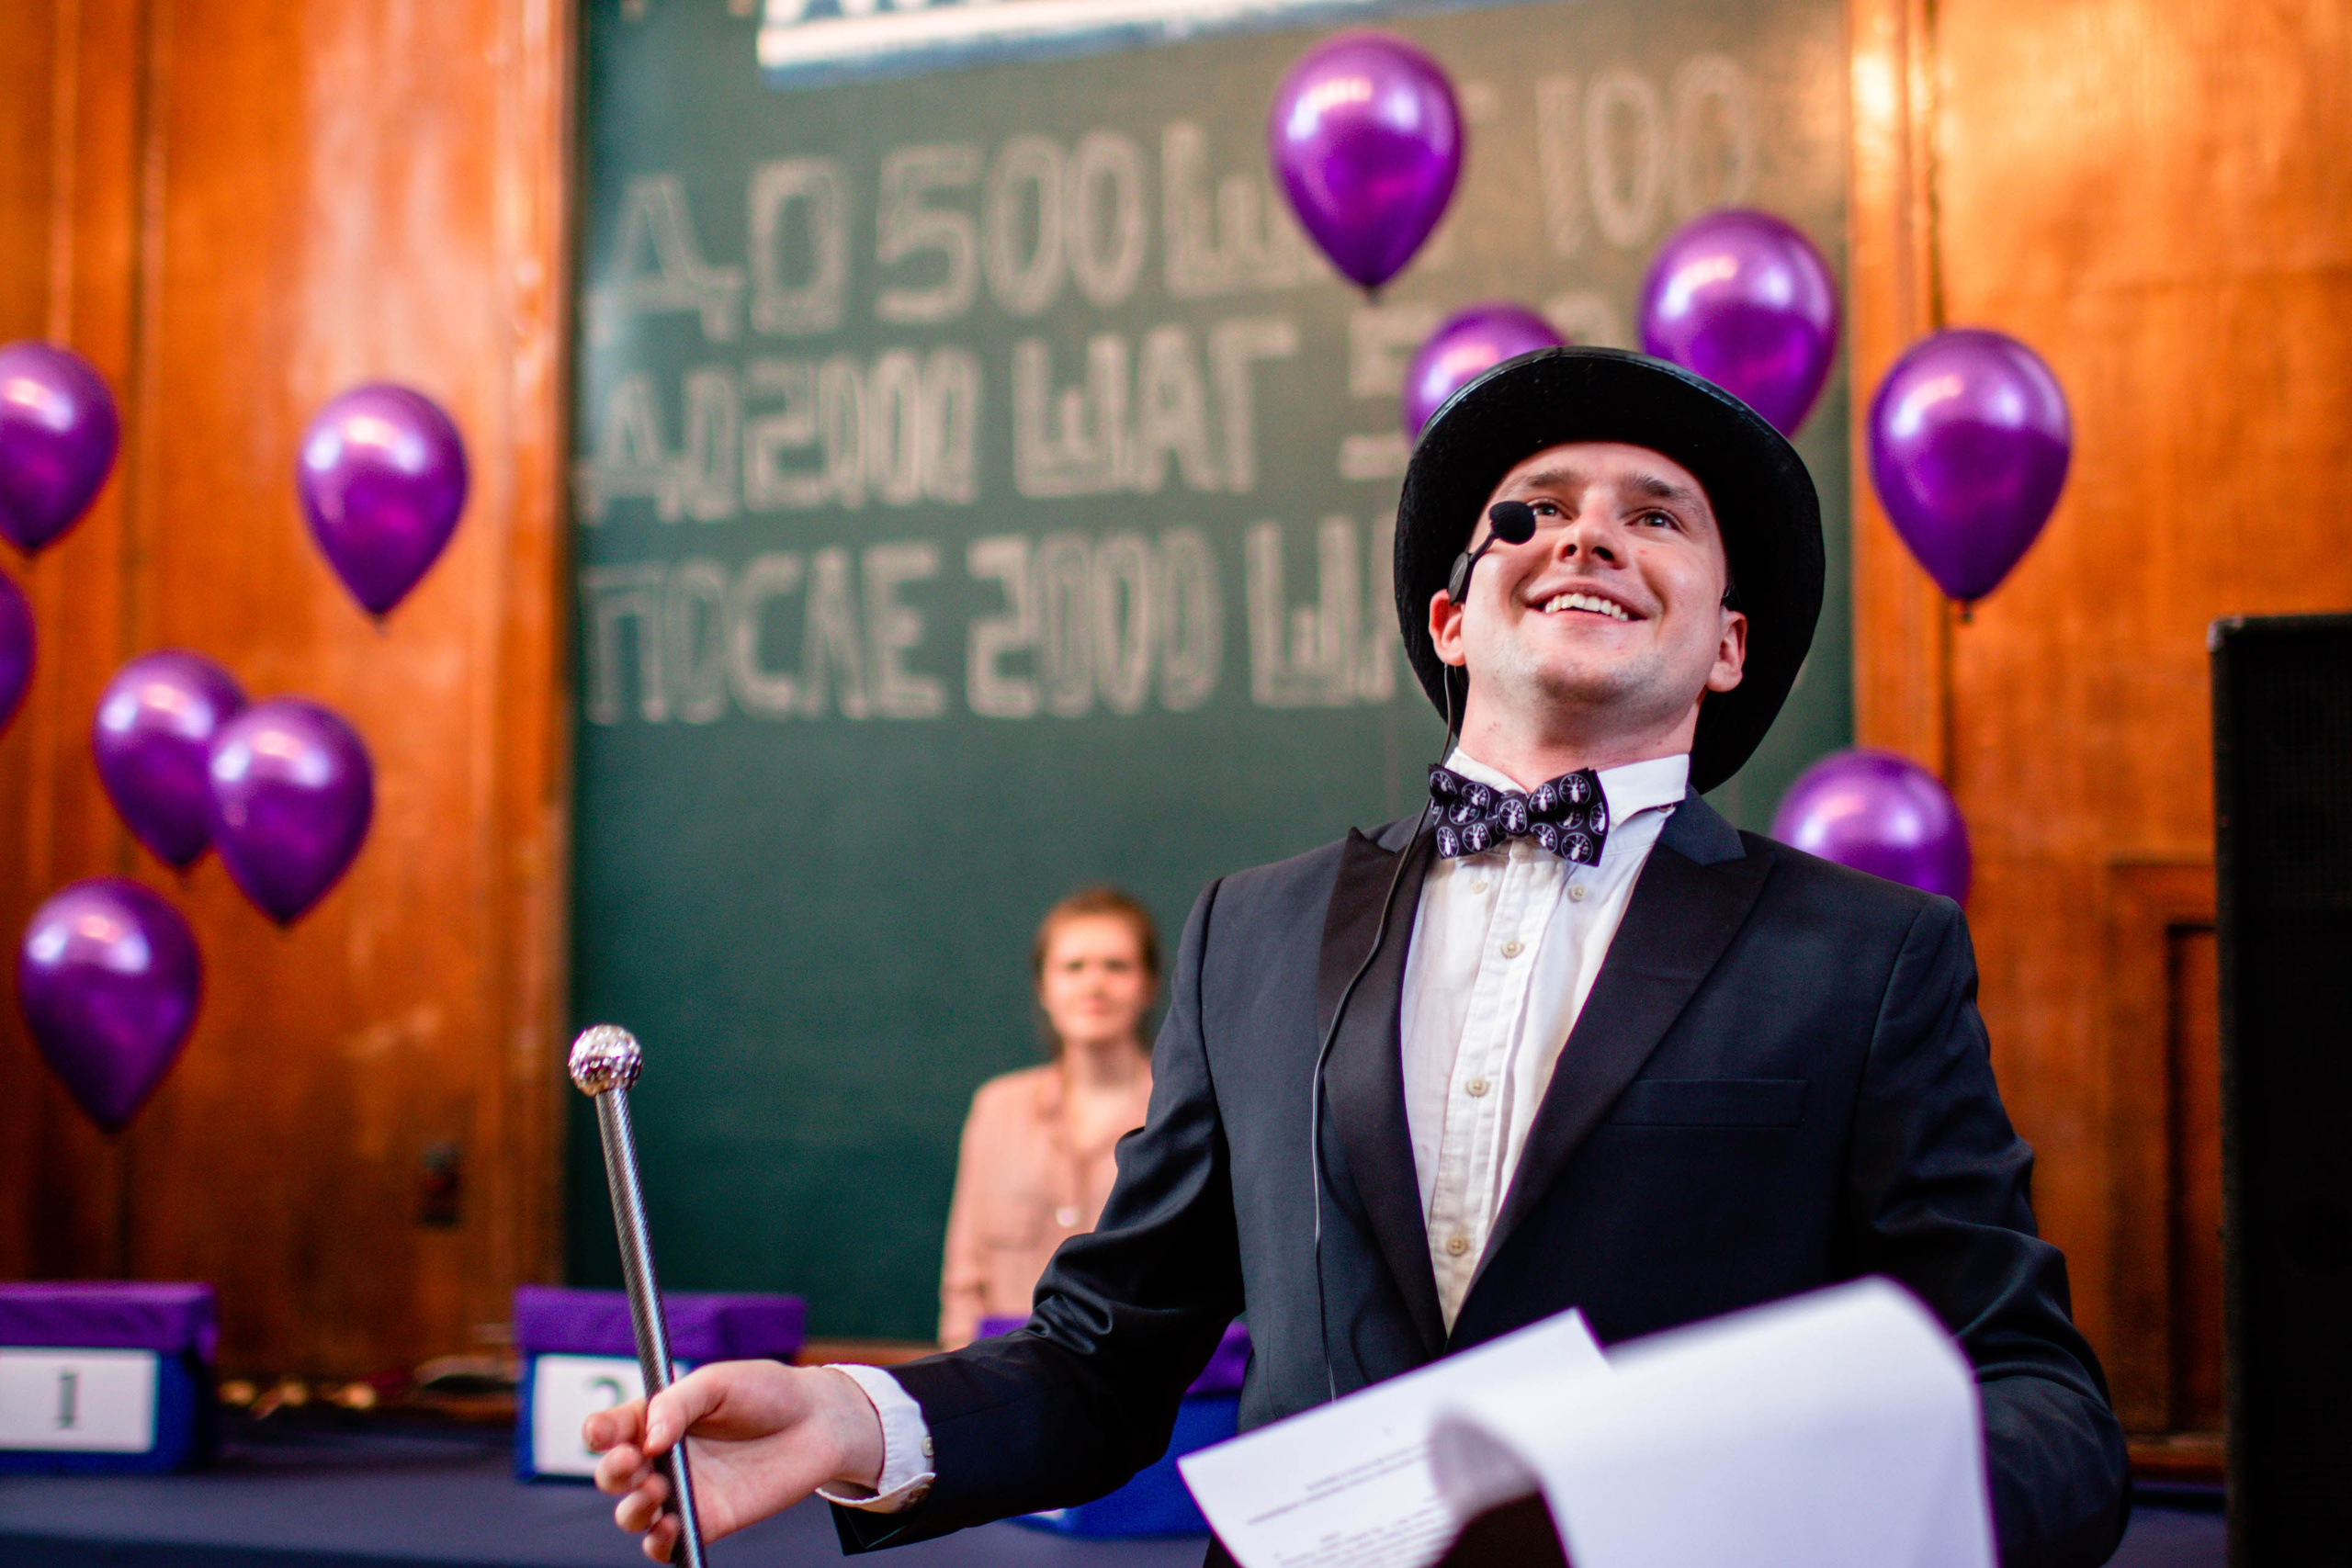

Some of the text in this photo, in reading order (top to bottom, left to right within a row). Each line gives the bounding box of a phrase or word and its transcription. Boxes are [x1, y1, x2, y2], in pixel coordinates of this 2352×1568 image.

[873, 129, 1145, 323] 500
[1012, 320, 1297, 498] ШАГ
[582, 538, 946, 726] ПОСЛЕ
[965, 527, 1222, 718] 2000
